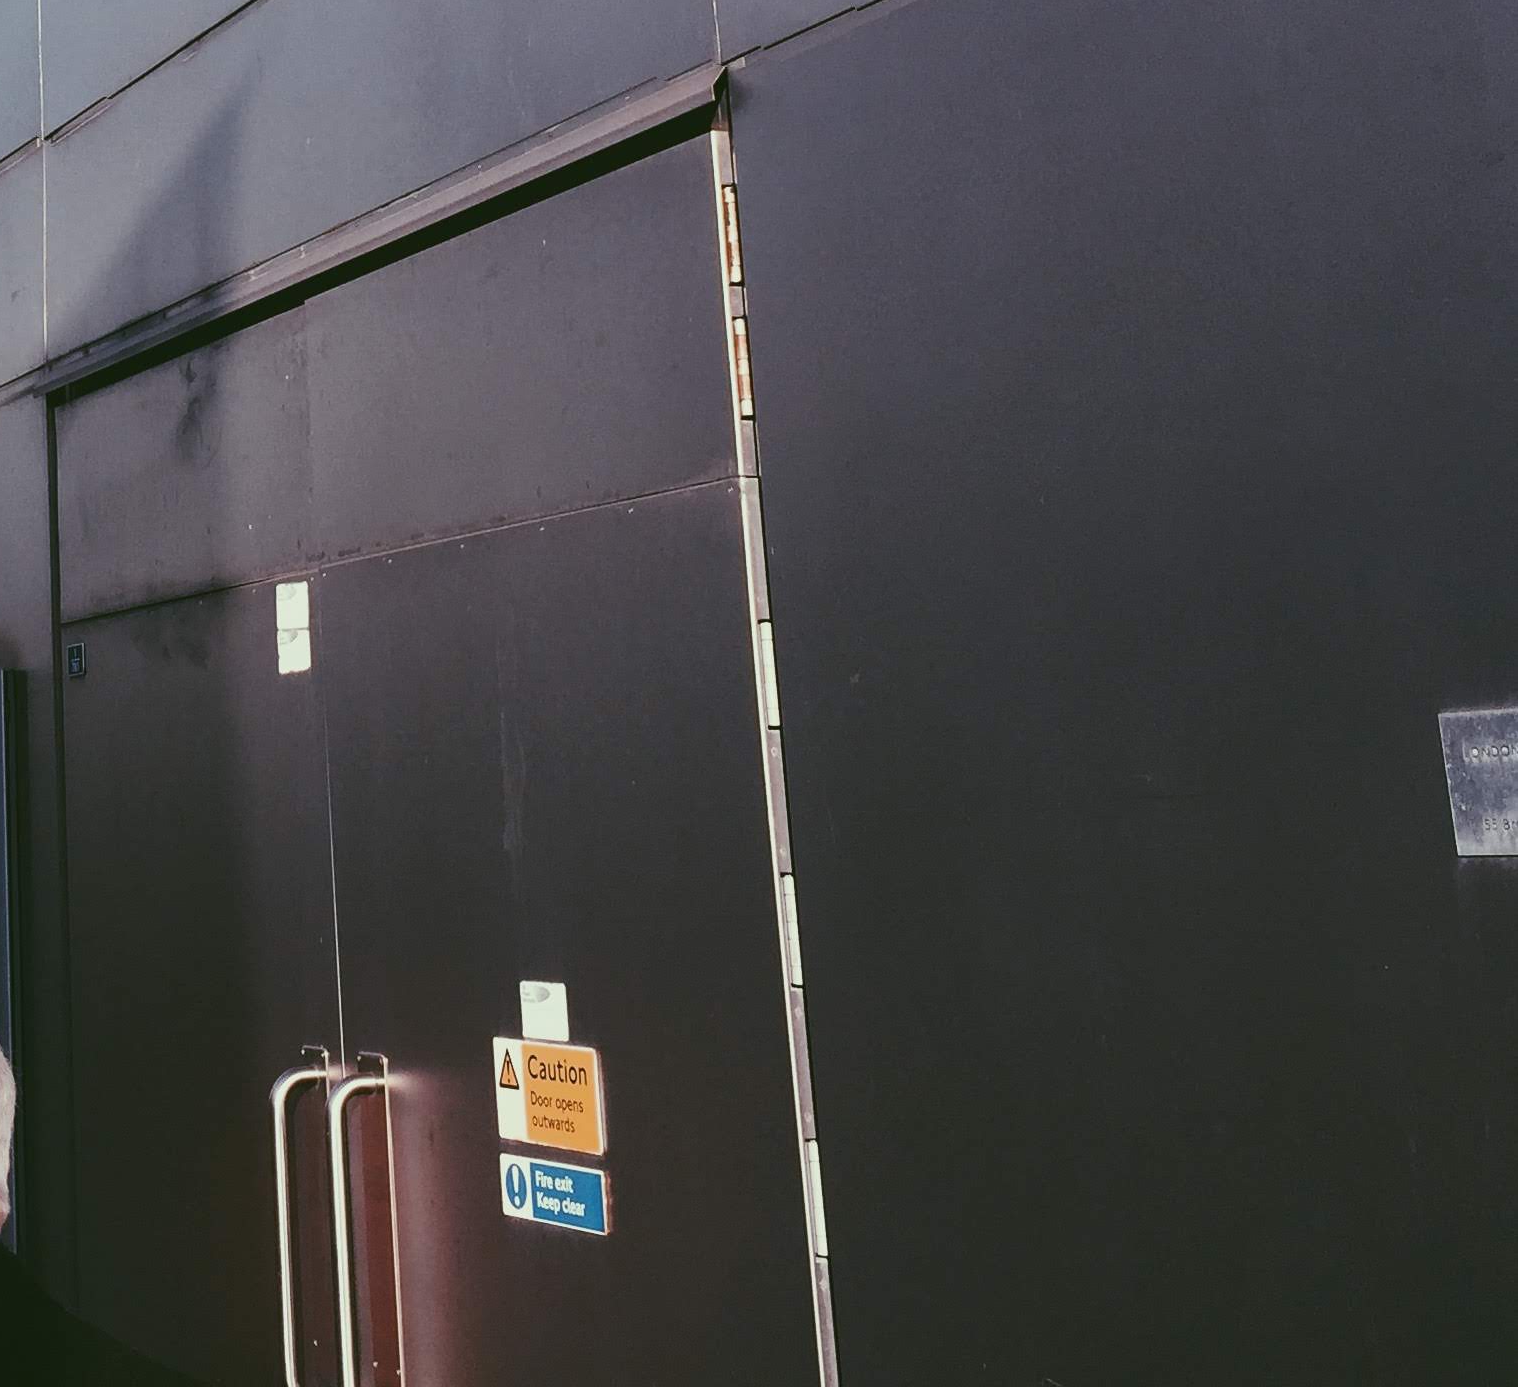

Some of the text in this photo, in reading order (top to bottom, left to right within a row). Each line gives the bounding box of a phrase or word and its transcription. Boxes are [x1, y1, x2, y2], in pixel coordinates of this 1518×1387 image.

[527, 1054, 588, 1086] Caution
[530, 1090, 584, 1114] Door opens
[532, 1115, 576, 1133] outwards
[535, 1170, 574, 1193] Fire exit
[536, 1191, 586, 1216] Keep clear
